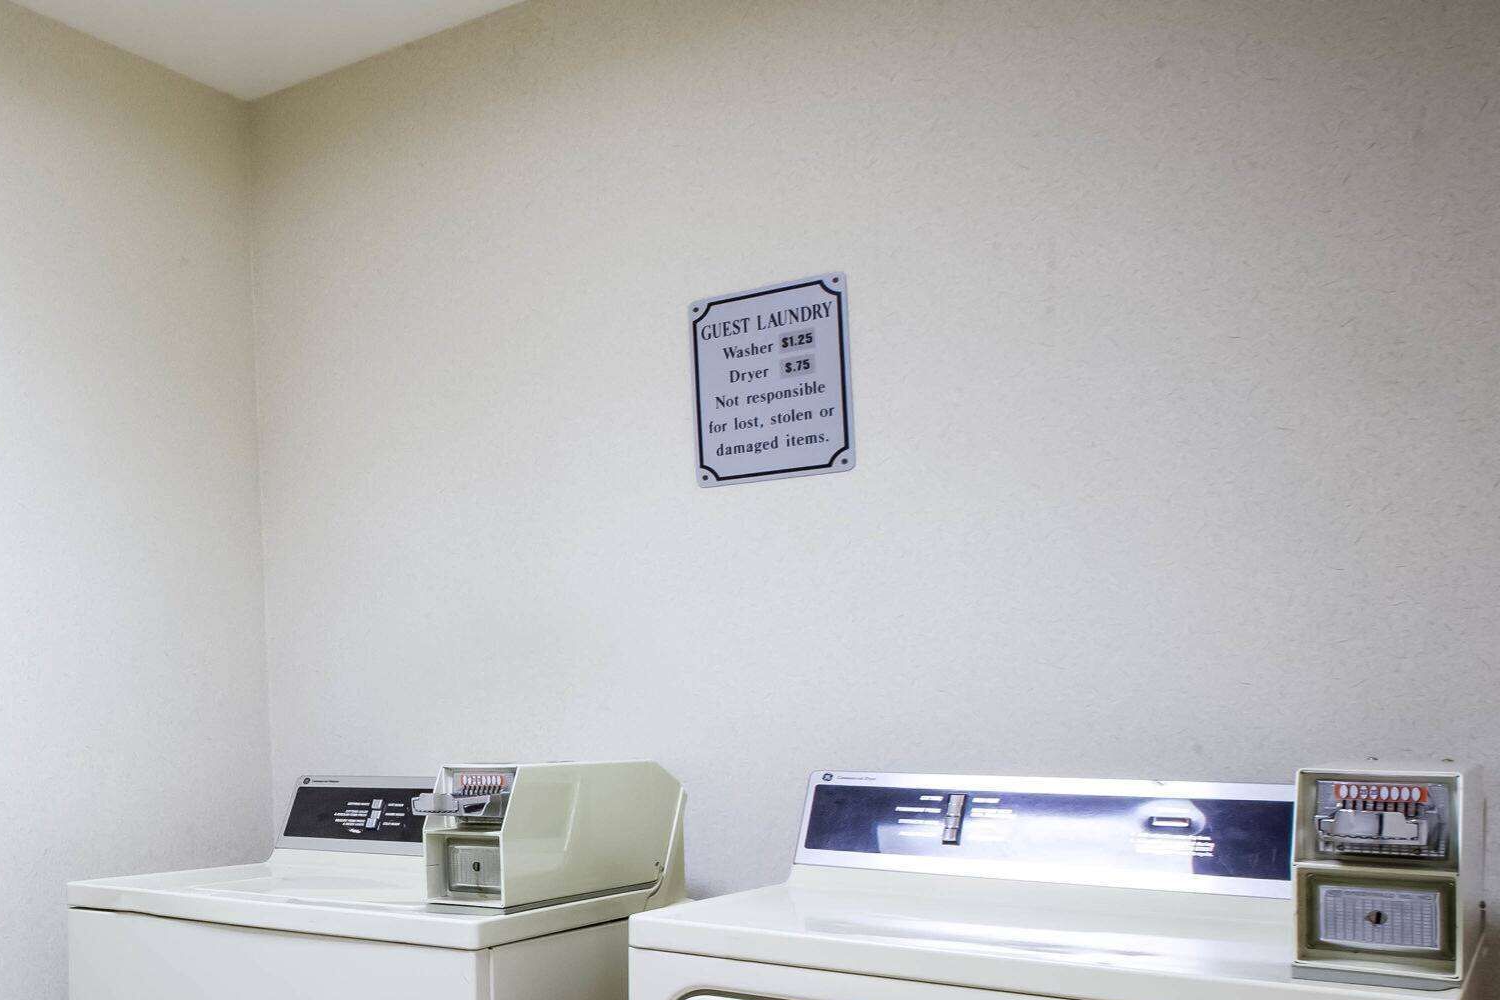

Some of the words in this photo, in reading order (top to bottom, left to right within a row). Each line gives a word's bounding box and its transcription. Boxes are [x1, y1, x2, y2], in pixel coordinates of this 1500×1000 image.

[701, 317, 750, 340] GUEST
[757, 301, 832, 330] LAUNDRY
[723, 342, 773, 359] Washer
[781, 333, 813, 348] $1.25
[729, 368, 769, 383] Dryer
[785, 359, 810, 373] $.75
[715, 395, 739, 409] Not
[746, 381, 825, 404] responsible
[709, 421, 727, 434] for
[734, 417, 764, 430] lost,
[770, 409, 812, 425] stolen
[820, 407, 835, 417] or
[716, 436, 778, 456] damaged
[786, 434, 829, 447] items.
